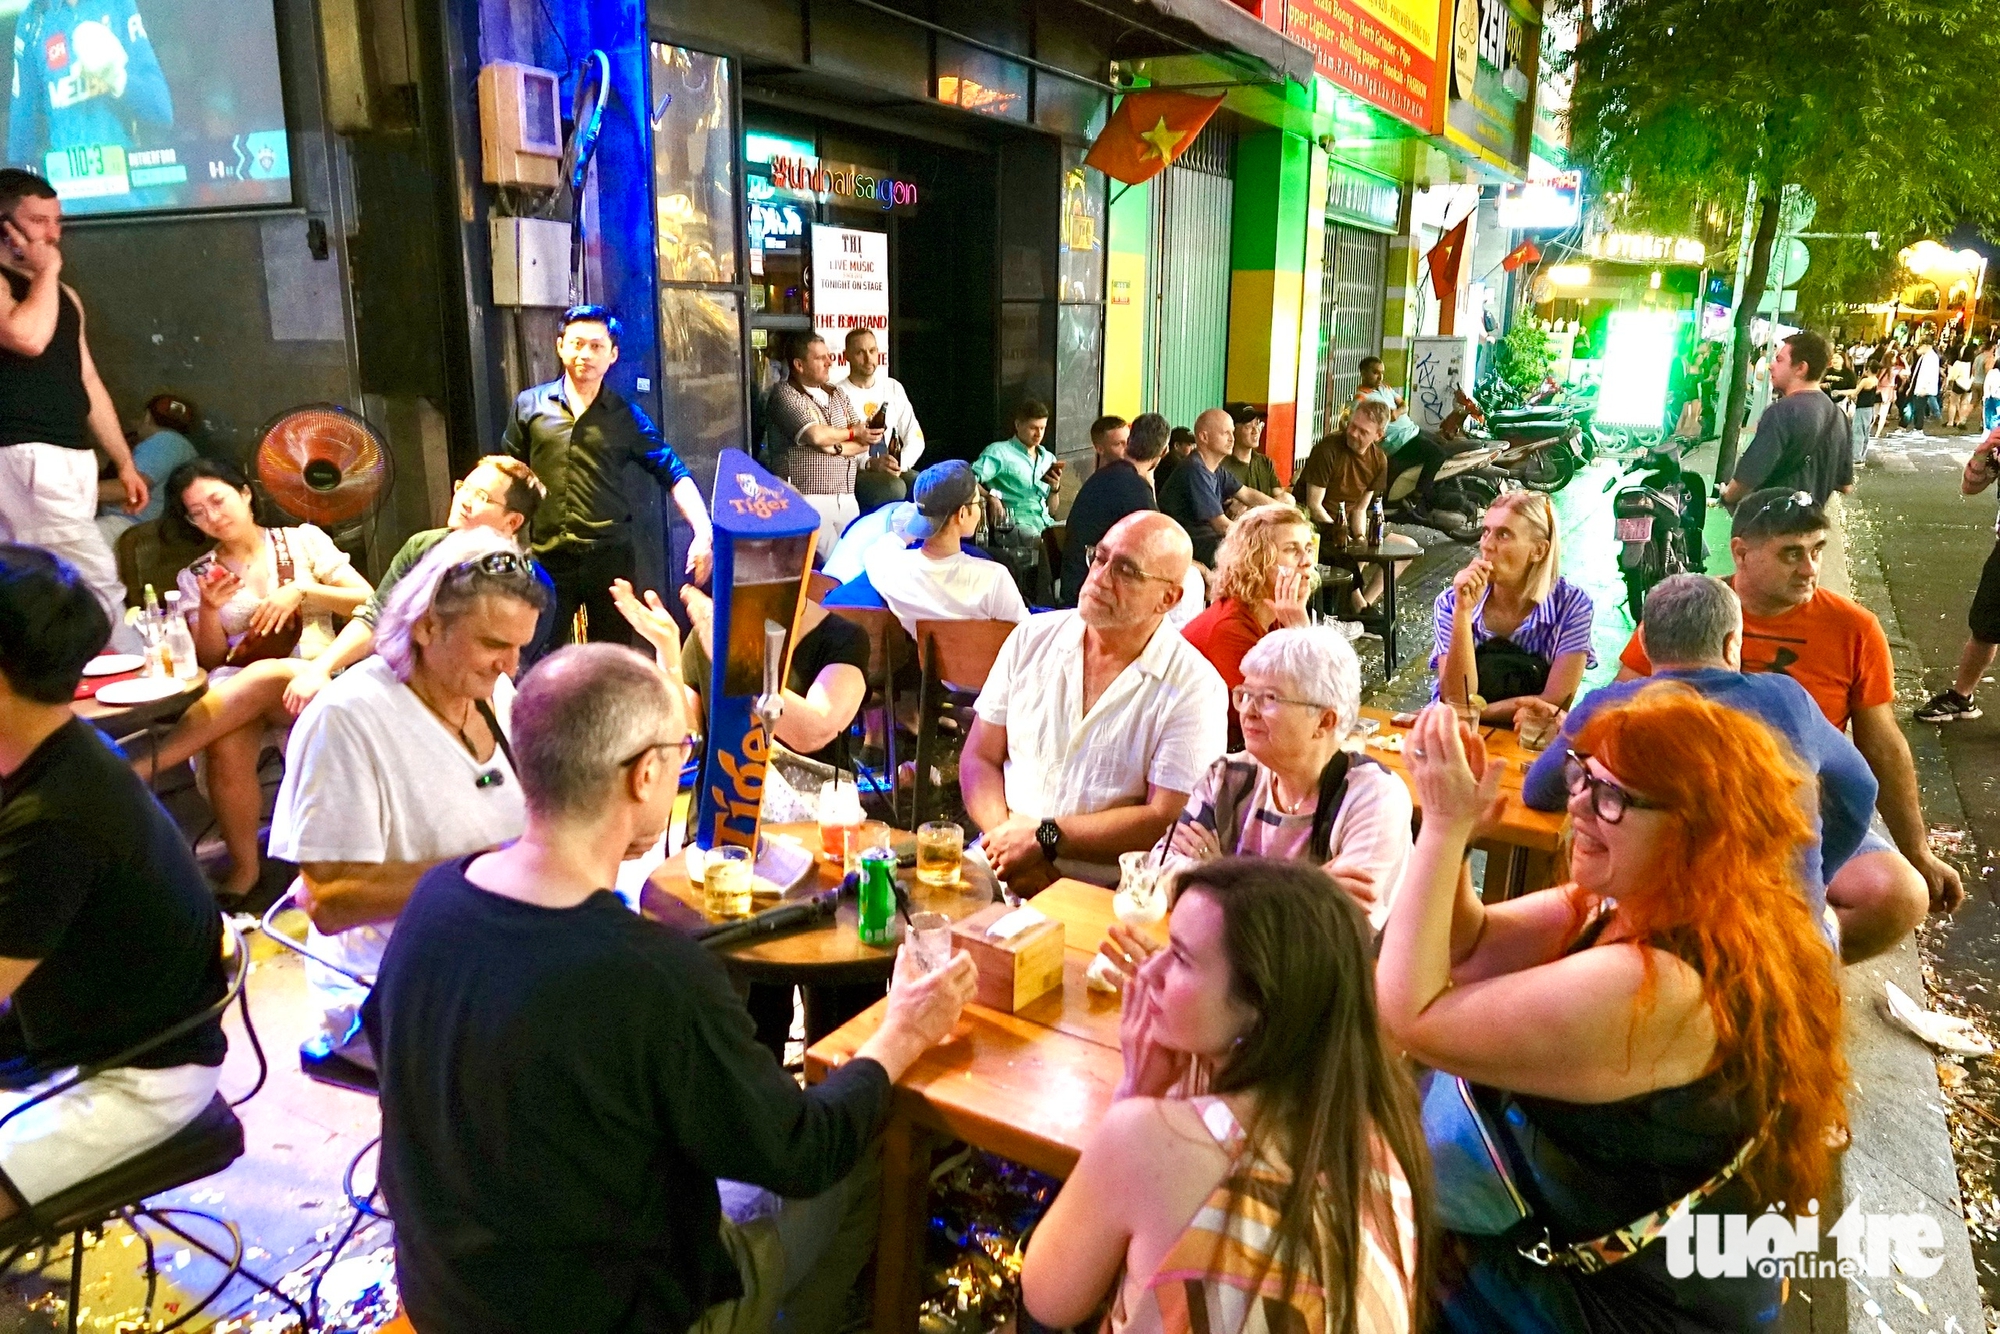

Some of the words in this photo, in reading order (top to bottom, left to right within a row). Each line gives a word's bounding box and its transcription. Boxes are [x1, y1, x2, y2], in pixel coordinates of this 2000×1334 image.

[1309, 12, 1335, 43] Lighter
[1340, 31, 1362, 65] Rolling
[1362, 49, 1380, 71] paper
[829, 260, 848, 271] LIVE
[849, 261, 875, 273] MUSIC
[821, 279, 850, 290] TONIGHT
[852, 281, 862, 291] ON
[863, 281, 883, 292] STAGE
[814, 314, 835, 329] THE
[729, 497, 789, 518] Tiger
